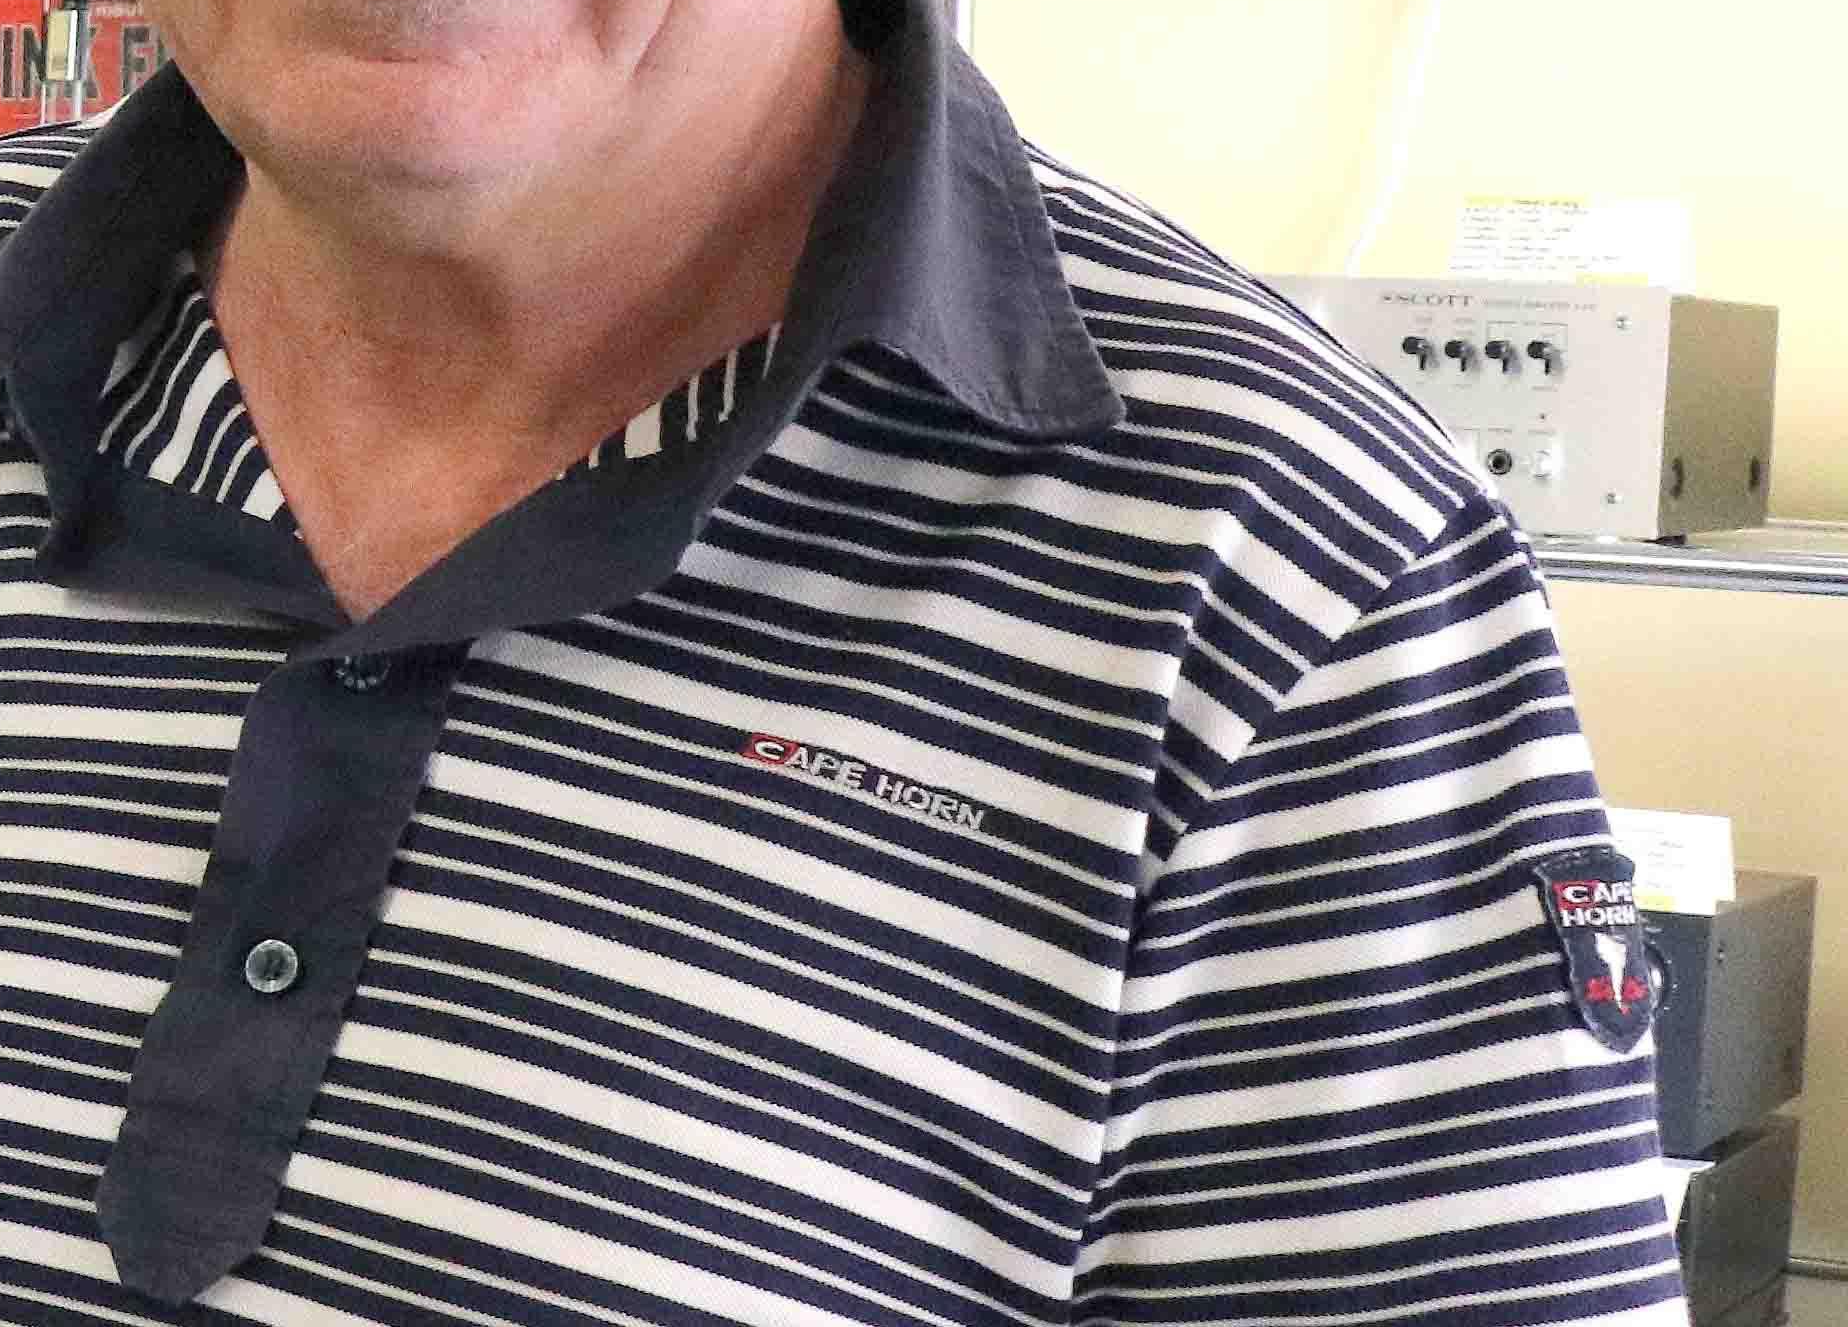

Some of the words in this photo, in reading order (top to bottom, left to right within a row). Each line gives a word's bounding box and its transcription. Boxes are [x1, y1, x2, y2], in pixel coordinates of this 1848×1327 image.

[1392, 294, 1475, 308] SCOTT
[754, 740, 866, 789] CAPE
[876, 774, 985, 832] HORN
[1560, 906, 1637, 927] HORN
